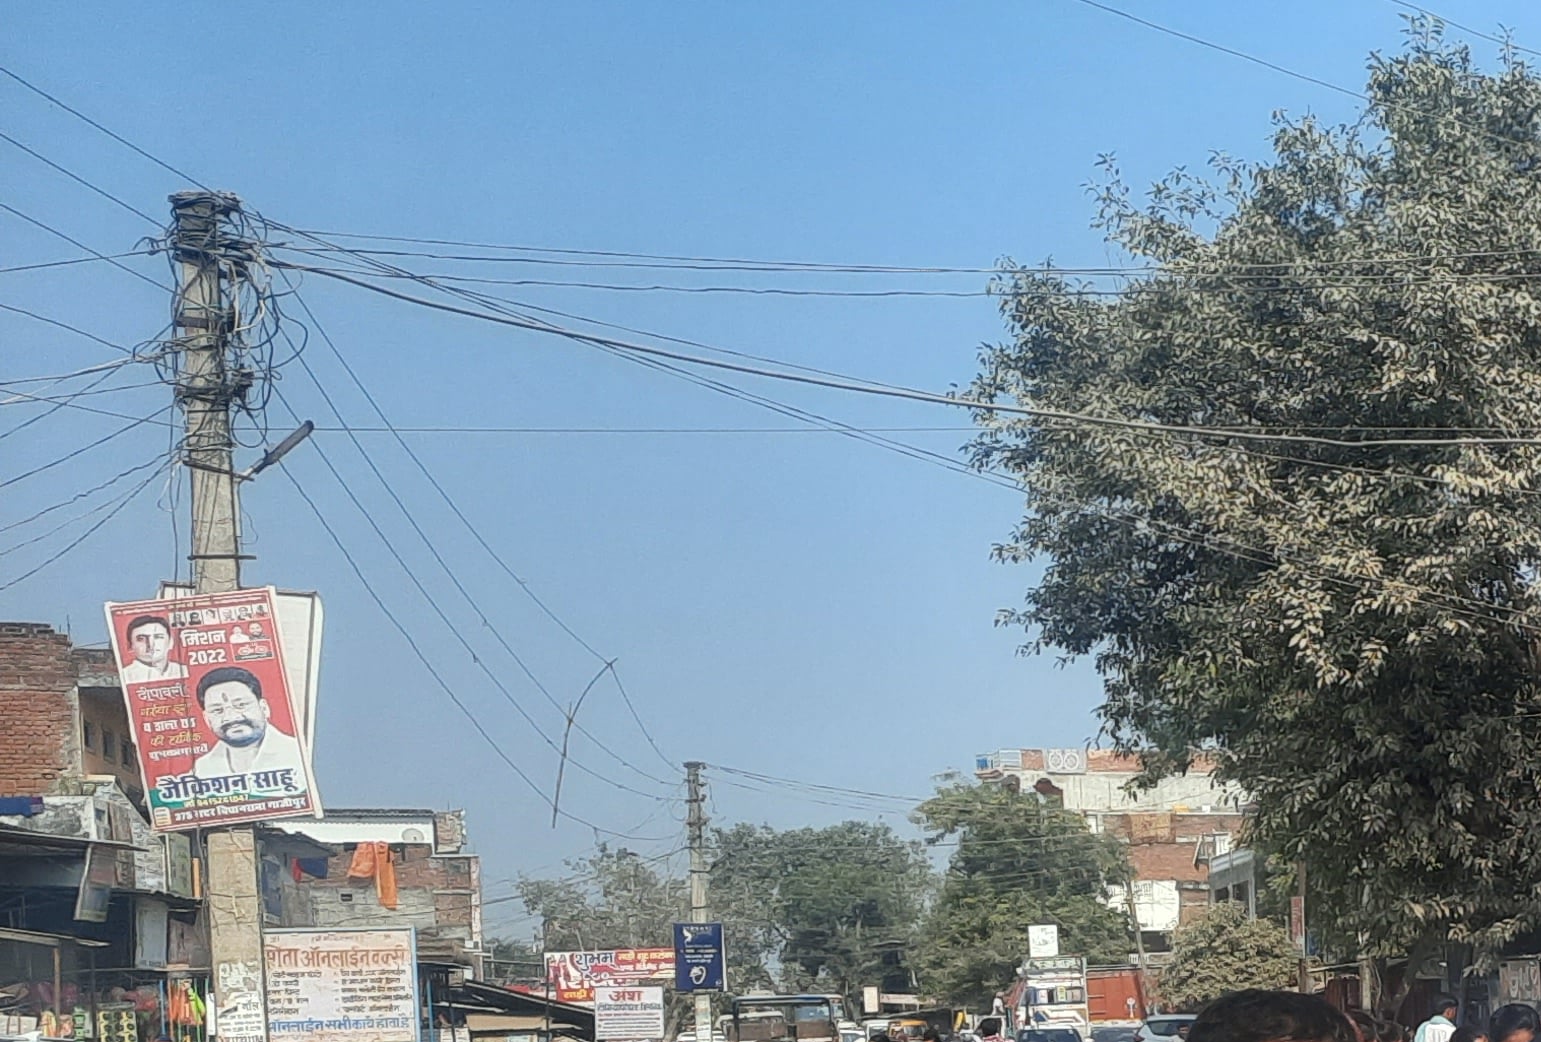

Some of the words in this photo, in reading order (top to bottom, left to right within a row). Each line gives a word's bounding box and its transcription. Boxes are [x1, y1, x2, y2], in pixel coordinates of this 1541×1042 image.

[180, 629, 227, 647] मिशन
[188, 649, 227, 665] 2022
[158, 773, 248, 799] जैकिशन
[250, 768, 297, 792] साहू
[300, 946, 369, 967] ऑनलाईन
[325, 1016, 350, 1031] सभी
